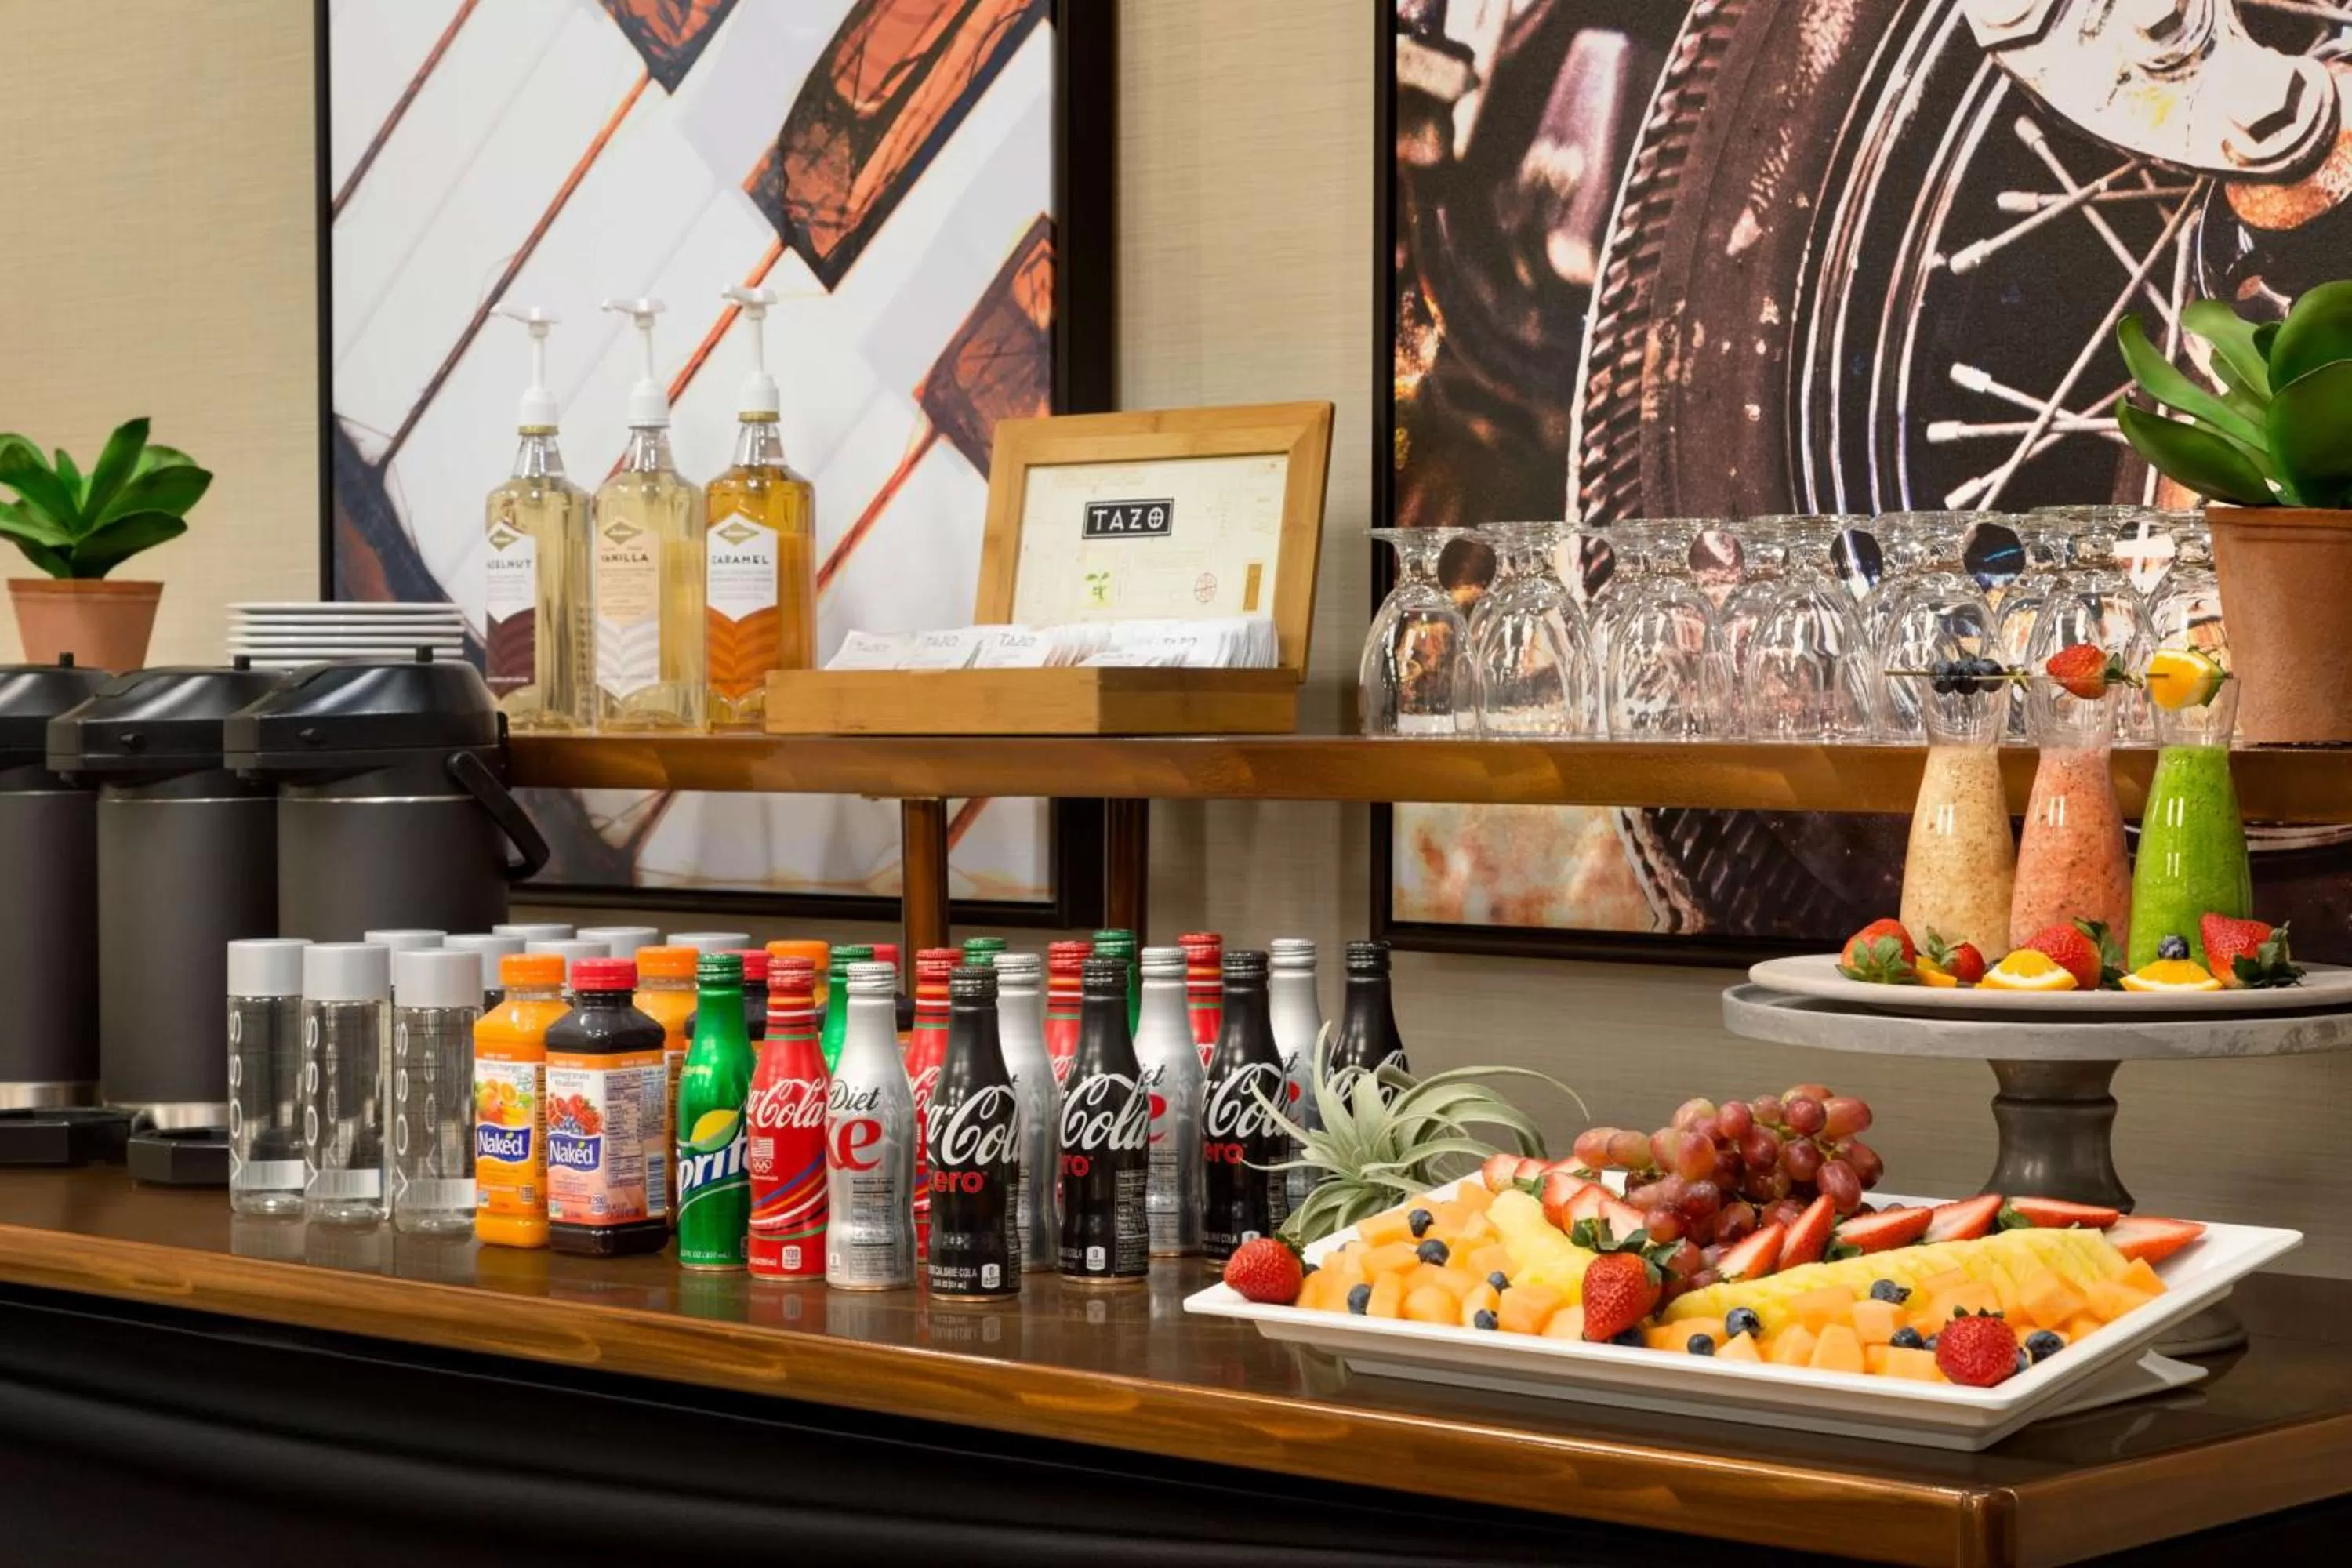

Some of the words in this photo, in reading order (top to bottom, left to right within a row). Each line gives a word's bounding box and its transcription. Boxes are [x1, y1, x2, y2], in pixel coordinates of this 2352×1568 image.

[1092, 506, 1164, 532] TAZO
[601, 553, 649, 562] VANILLA
[712, 554, 770, 565] CARAMEL
[747, 1078, 826, 1129] a-Cola
[829, 1078, 880, 1111] Diet
[479, 1130, 523, 1156] Naked
[550, 1139, 593, 1165] Naked
[676, 1123, 750, 1206] prit
